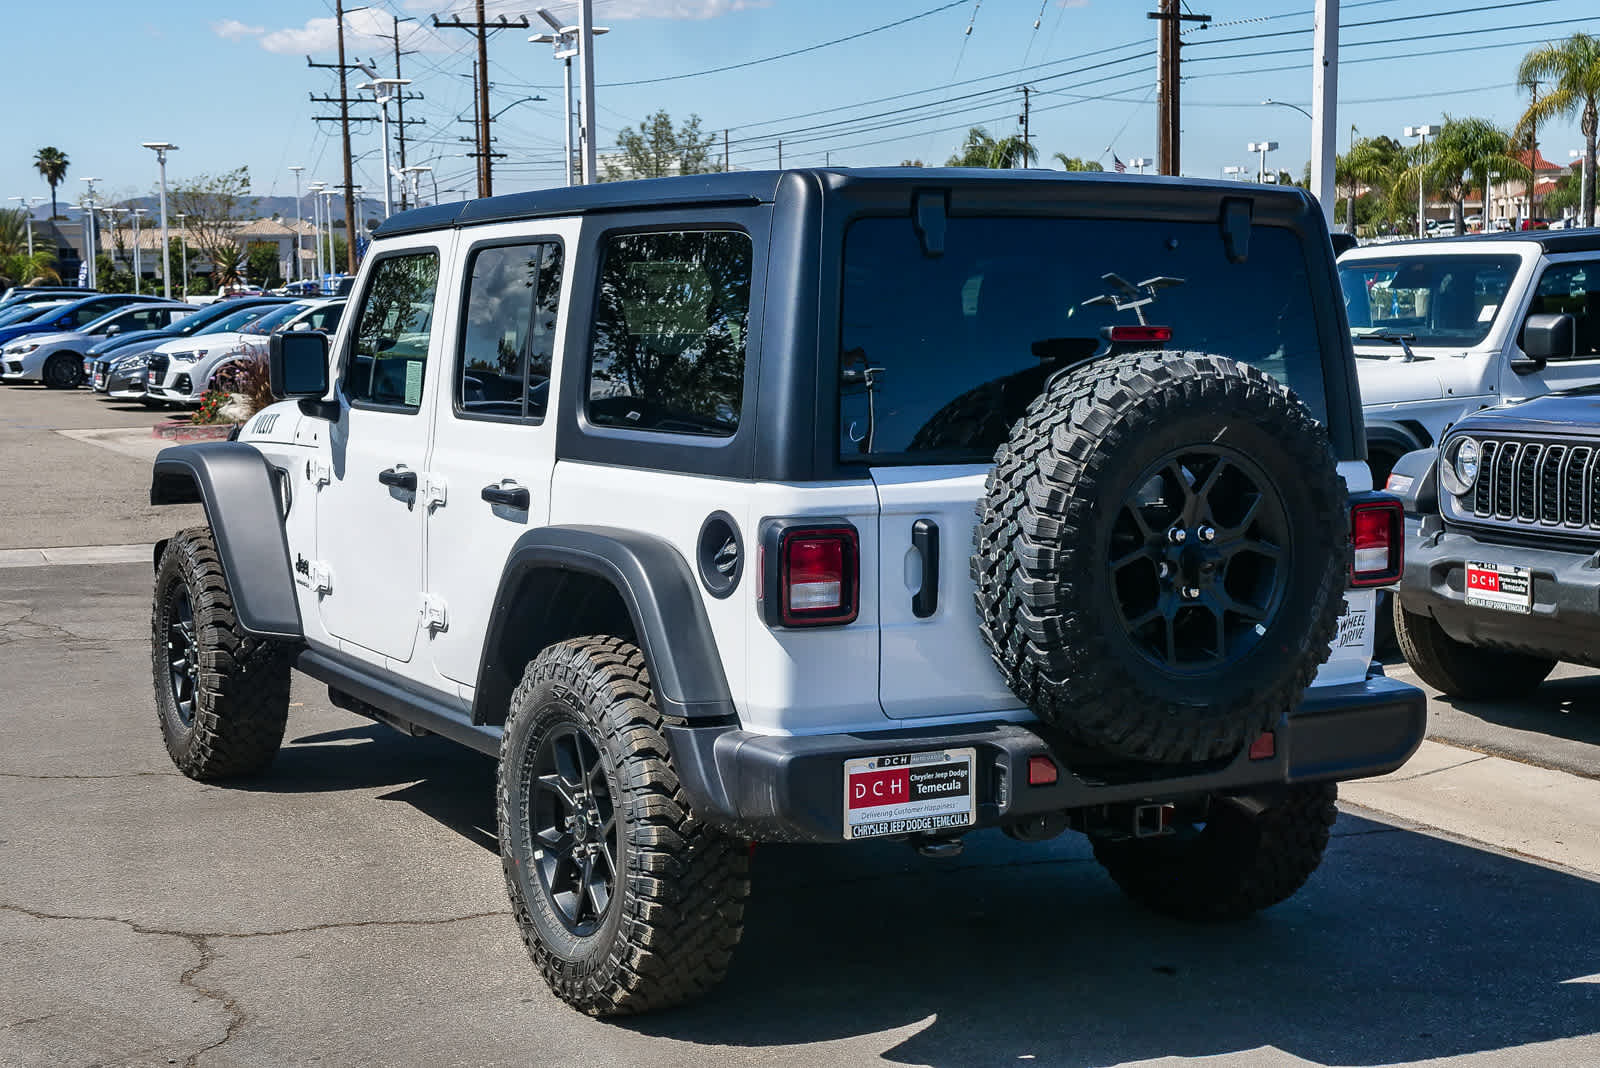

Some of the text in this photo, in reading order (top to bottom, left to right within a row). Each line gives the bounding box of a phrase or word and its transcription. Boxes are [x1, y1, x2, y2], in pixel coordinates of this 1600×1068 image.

[1471, 574, 1495, 587] DCH
[1340, 615, 1366, 632] WHEEL
[1340, 627, 1365, 647] DRIVE
[884, 756, 908, 766] DCH
[910, 768, 968, 782] Chrysler Jeep Dodge
[855, 778, 903, 799] DCH
[916, 779, 961, 794] Temecula
[893, 805, 924, 817] Customer
[853, 813, 969, 837] CHRYSLER JEEP DODGE TEMECULA
